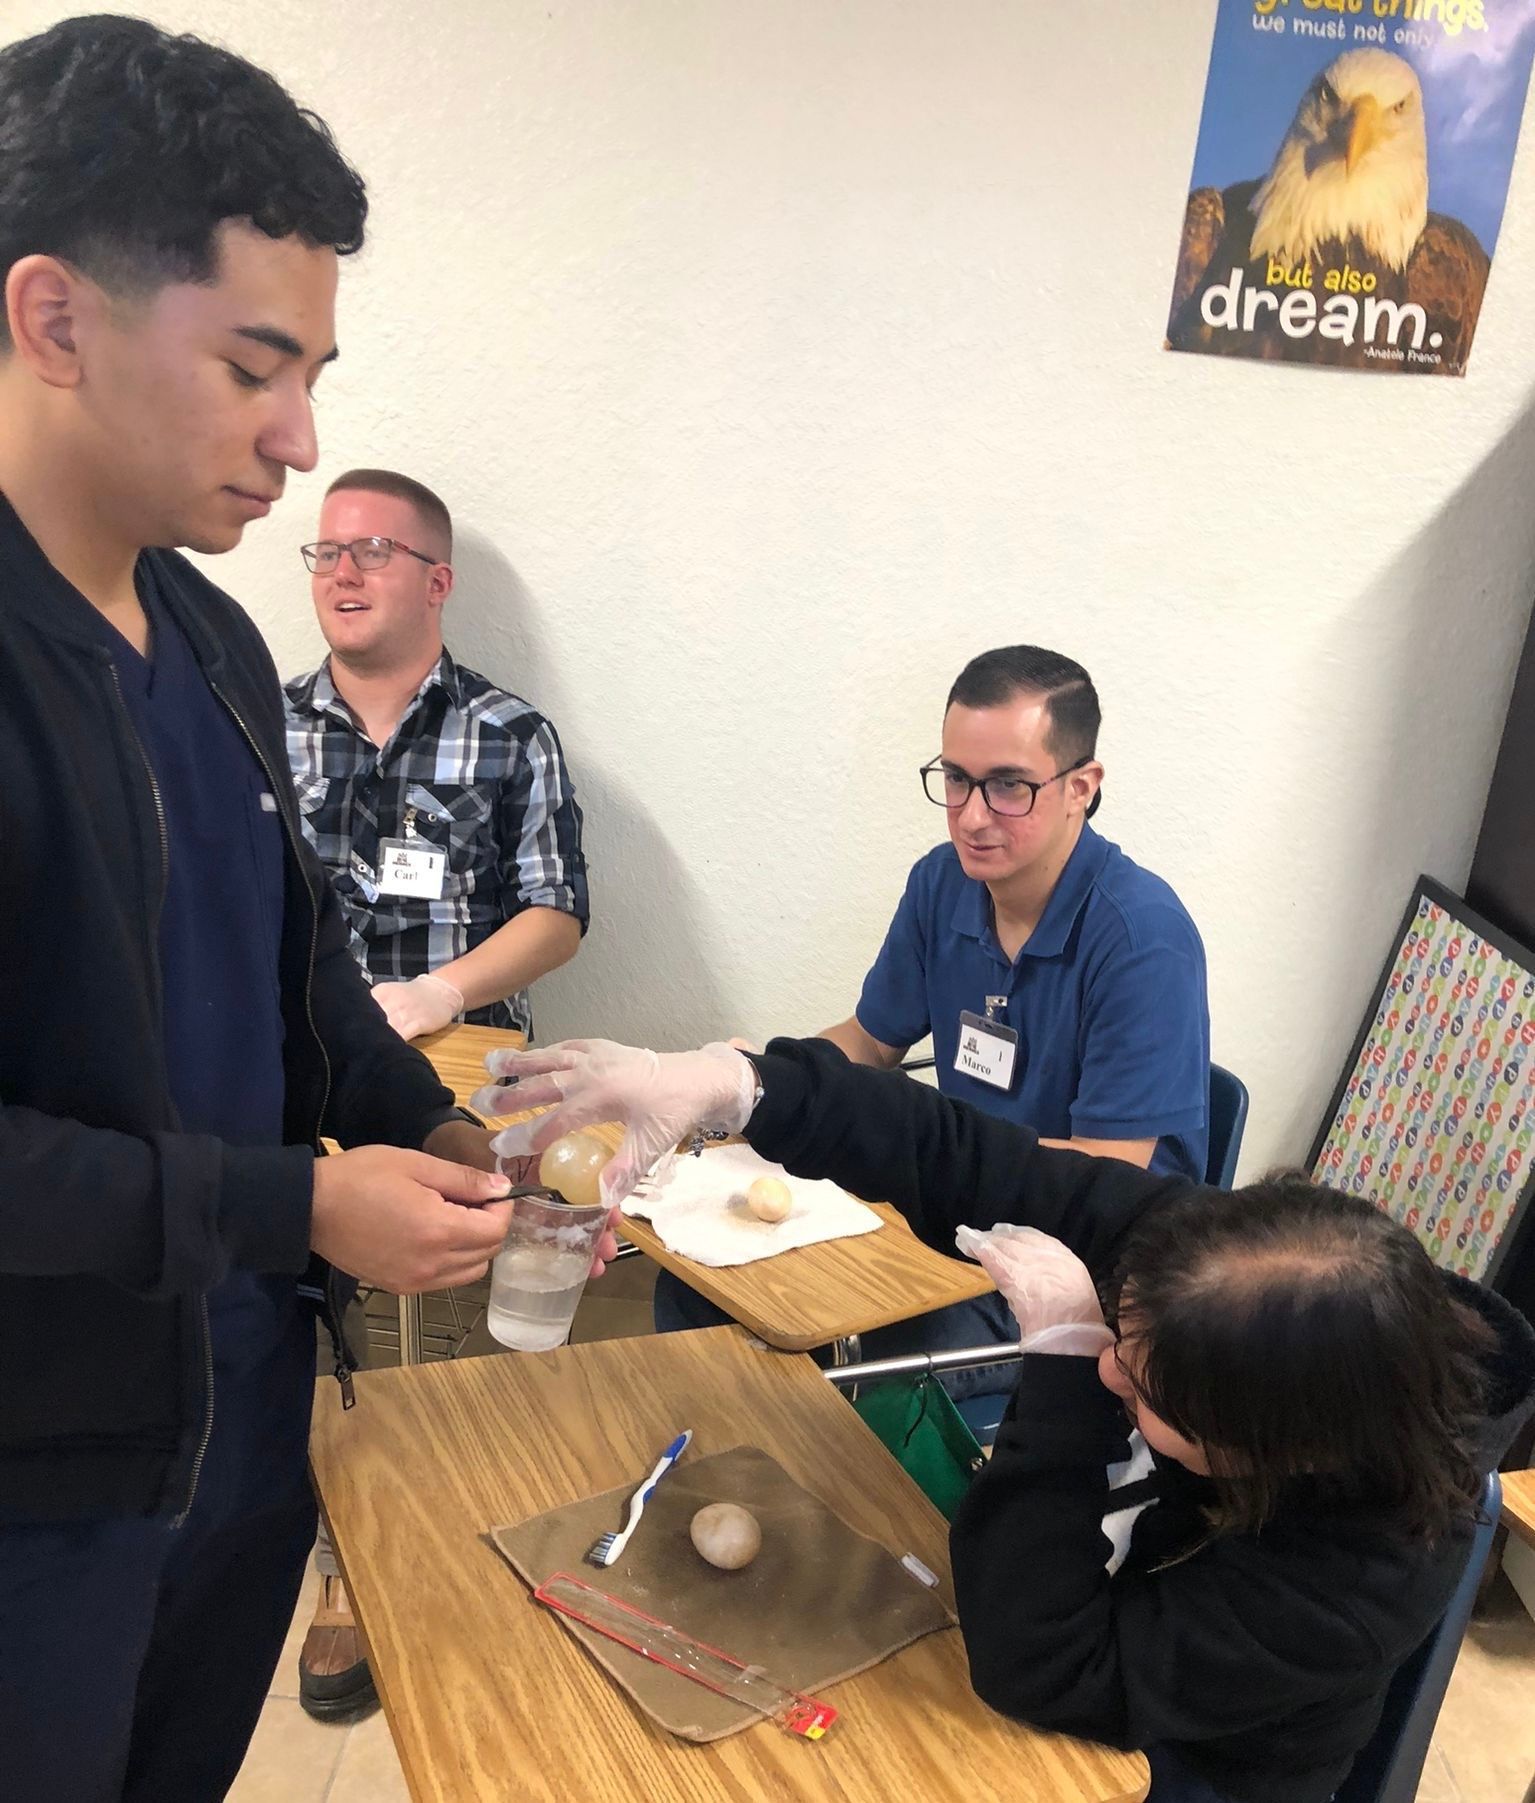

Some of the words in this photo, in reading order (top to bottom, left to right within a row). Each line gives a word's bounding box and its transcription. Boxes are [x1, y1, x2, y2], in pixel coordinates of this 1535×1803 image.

[1252, 13, 1285, 34] we
[1293, 17, 1346, 40] must
[1354, 21, 1386, 44] not
[1266, 262, 1313, 289] but
[1324, 264, 1377, 293] also
[1200, 267, 1443, 349] dream.
[394, 868, 418, 881] Carl
[961, 1054, 991, 1076] Marco
